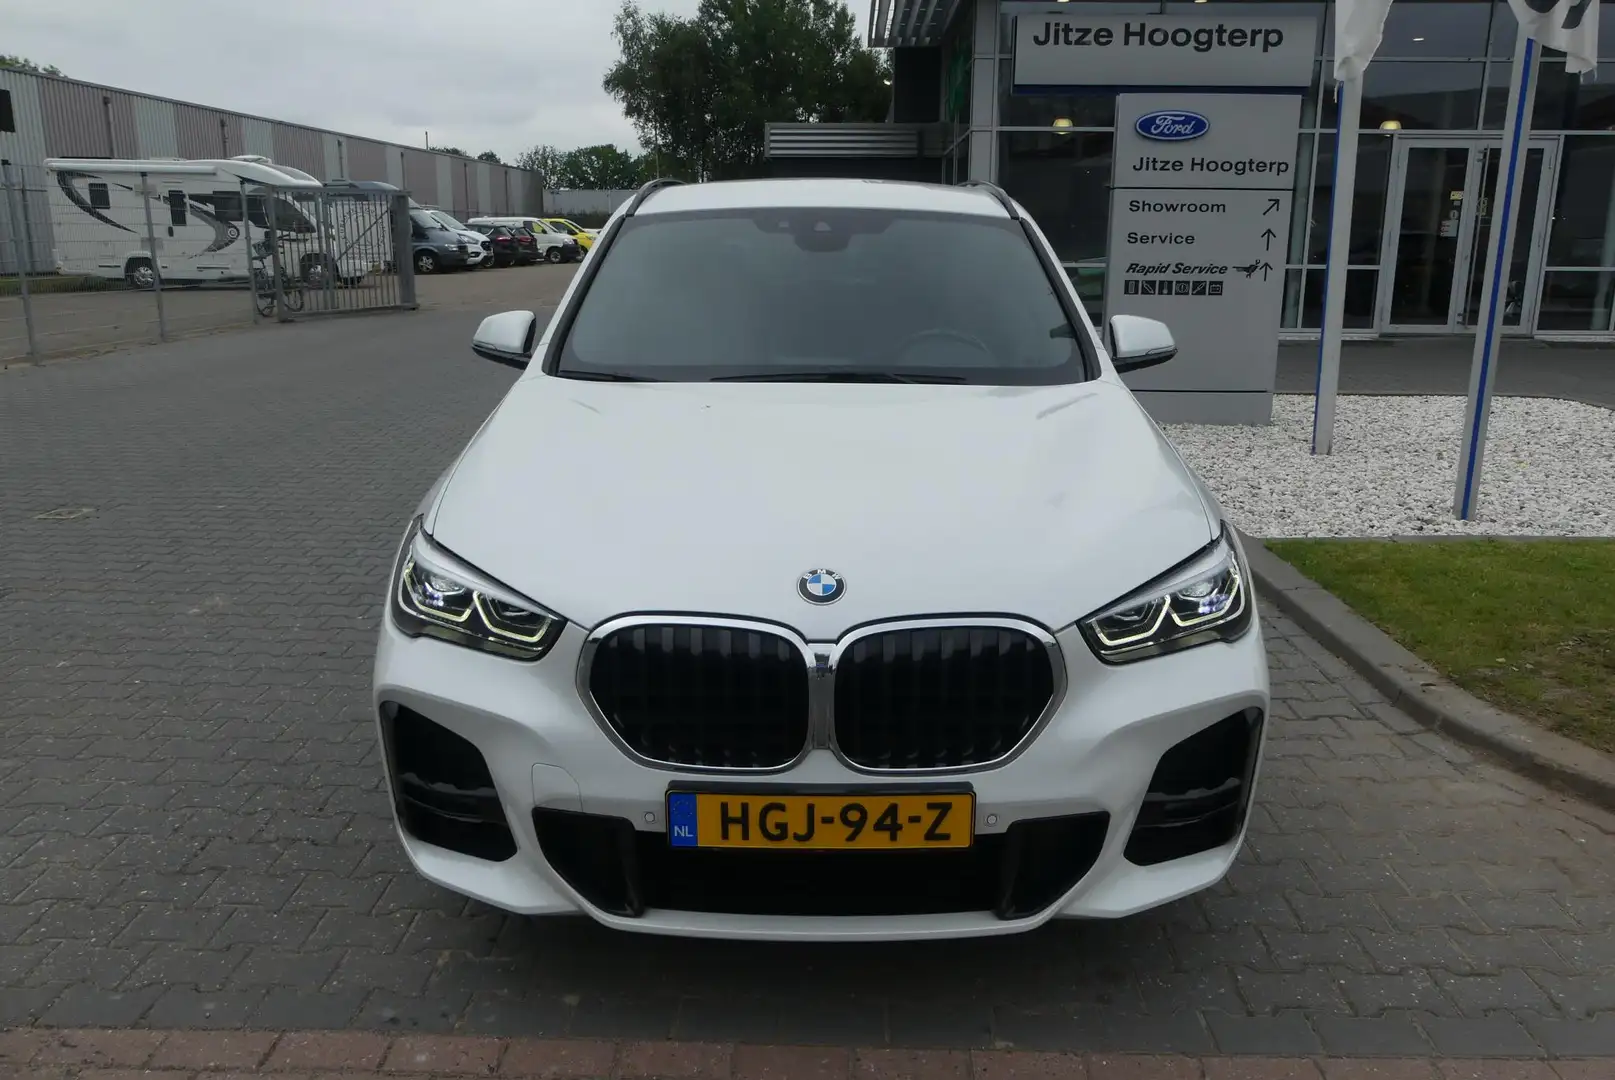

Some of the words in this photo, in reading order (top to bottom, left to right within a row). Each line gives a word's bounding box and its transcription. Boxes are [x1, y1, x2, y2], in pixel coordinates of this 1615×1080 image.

[1033, 22, 1113, 47] Jitze
[1124, 23, 1284, 52] Hoogterp
[1151, 115, 1195, 135] Ford
[1132, 157, 1184, 172] Jitze
[1190, 158, 1289, 176] Hoogterp
[1129, 200, 1226, 213] Showroom
[1127, 232, 1195, 245] Service
[1125, 262, 1170, 277] Rapid
[1172, 262, 1228, 275] Service
[720, 801, 953, 842] HGJ-94-Z
[674, 825, 694, 837] NL
